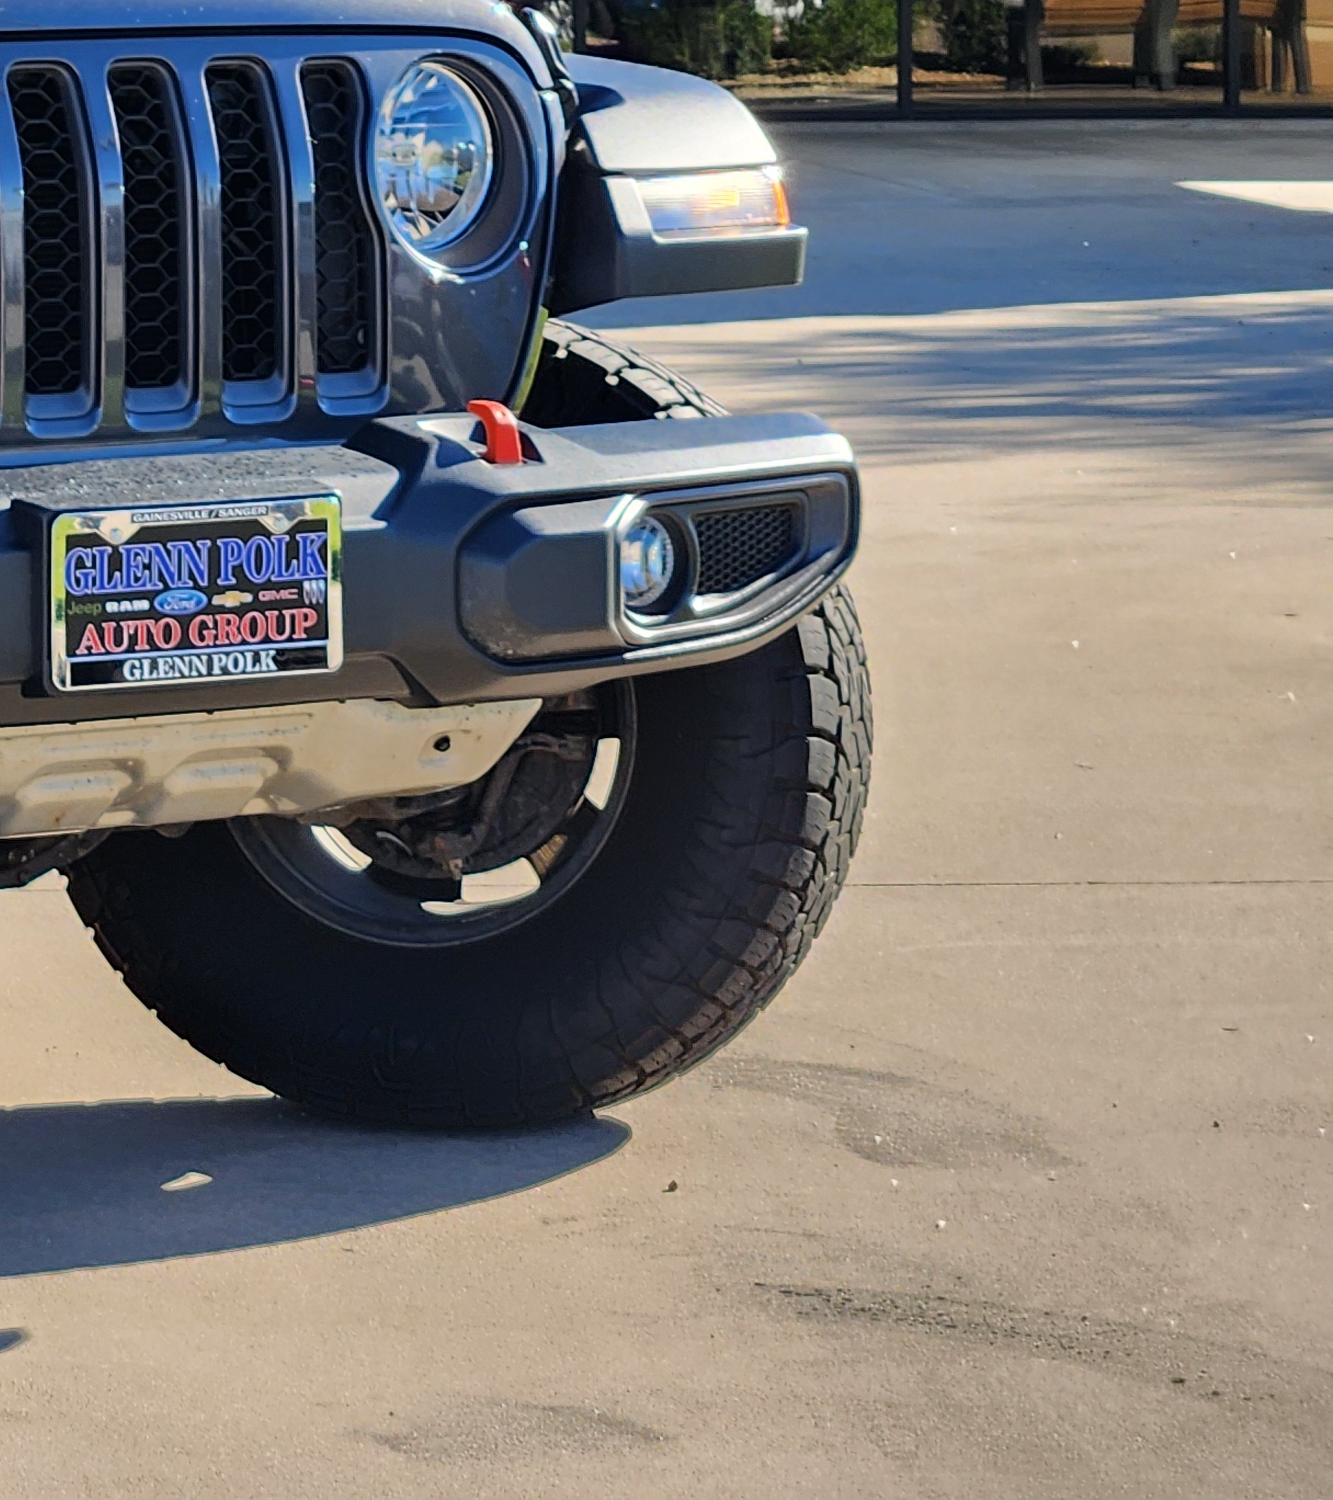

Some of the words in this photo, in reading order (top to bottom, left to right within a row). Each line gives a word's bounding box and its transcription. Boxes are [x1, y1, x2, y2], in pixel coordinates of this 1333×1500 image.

[64, 538, 211, 596] GLENN
[216, 531, 328, 587] POLK
[67, 601, 102, 616] Jeep
[104, 599, 150, 614] RAM
[258, 589, 299, 603] GMC
[75, 618, 182, 655] AUTO
[188, 607, 319, 648] GROUP
